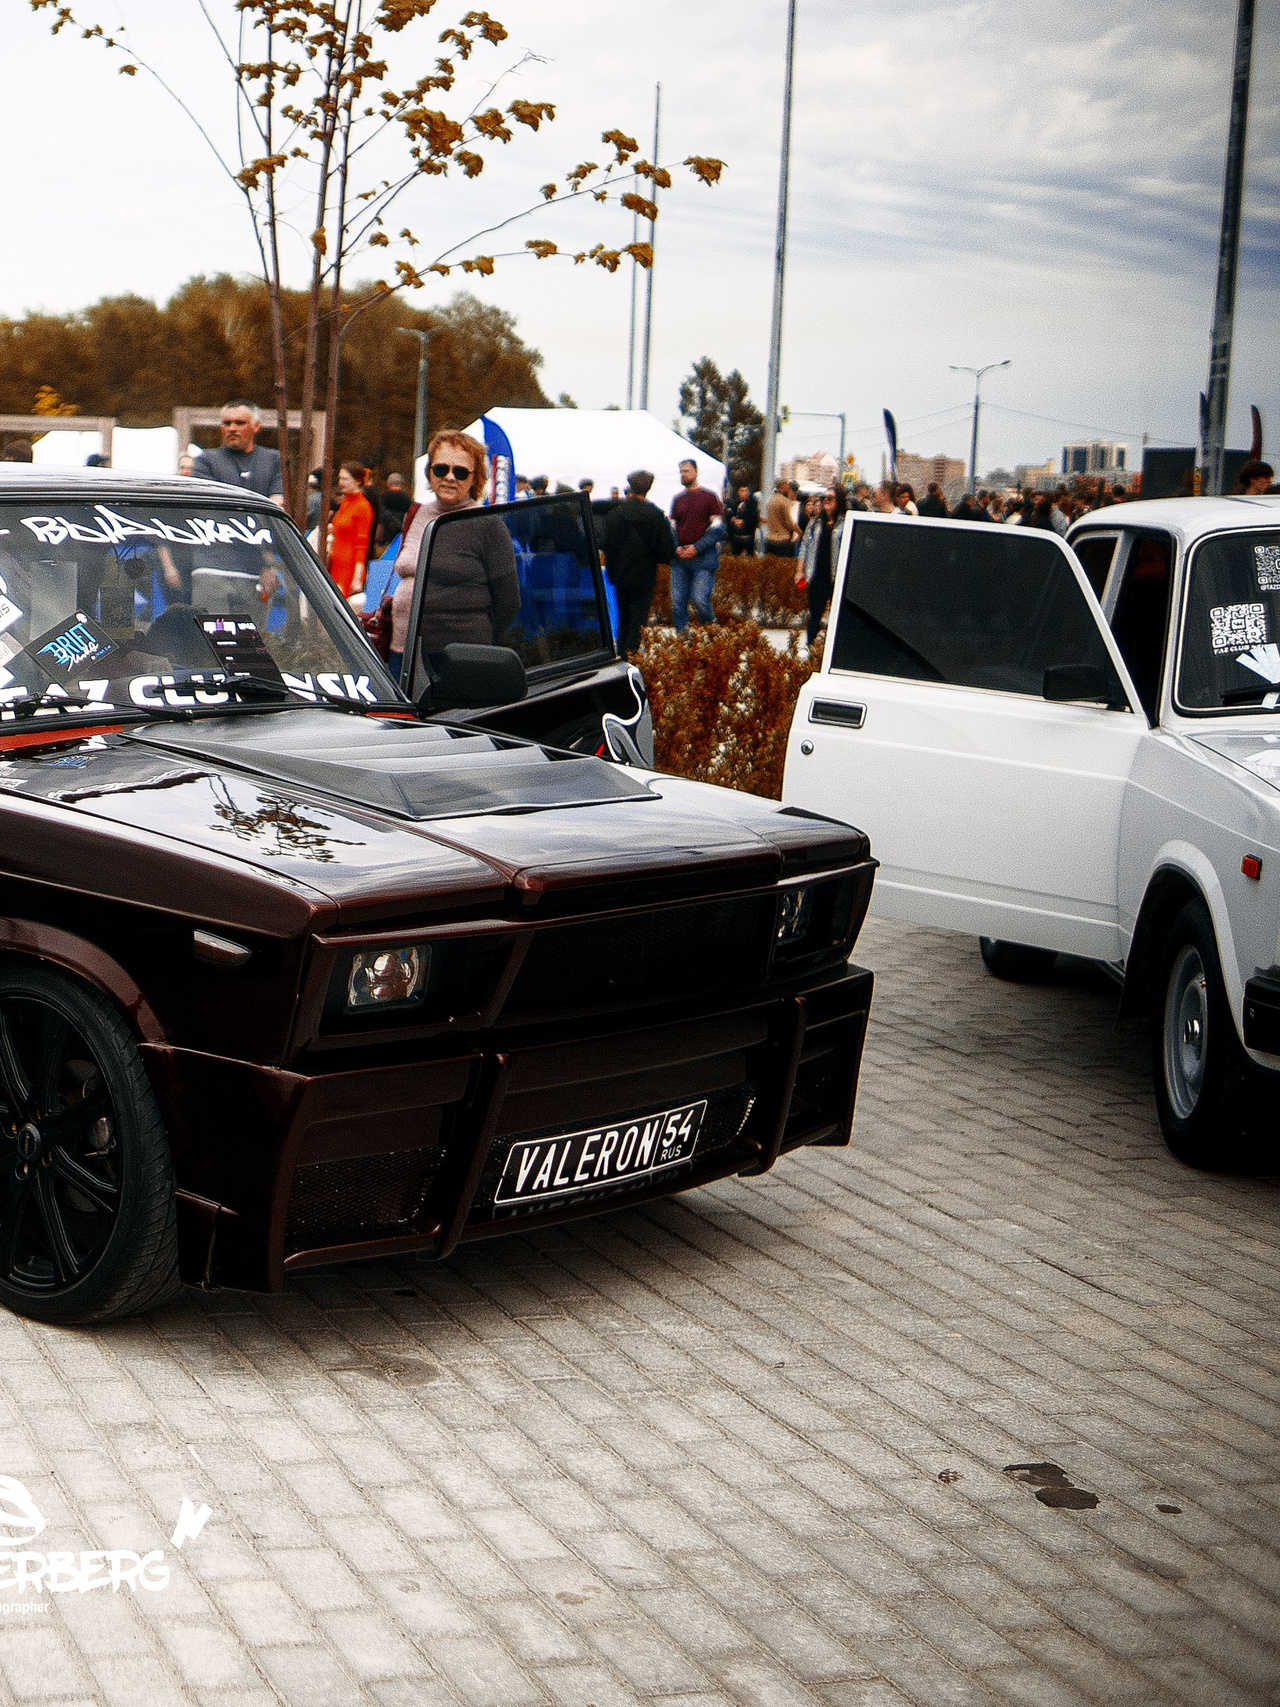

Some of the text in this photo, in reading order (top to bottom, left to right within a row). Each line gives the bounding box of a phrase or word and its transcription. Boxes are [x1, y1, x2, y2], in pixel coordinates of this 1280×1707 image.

[35, 622, 97, 666] DRIFT
[128, 673, 244, 706] CLU
[515, 1109, 695, 1193] VALERON 54
[660, 1146, 683, 1162] RUS
